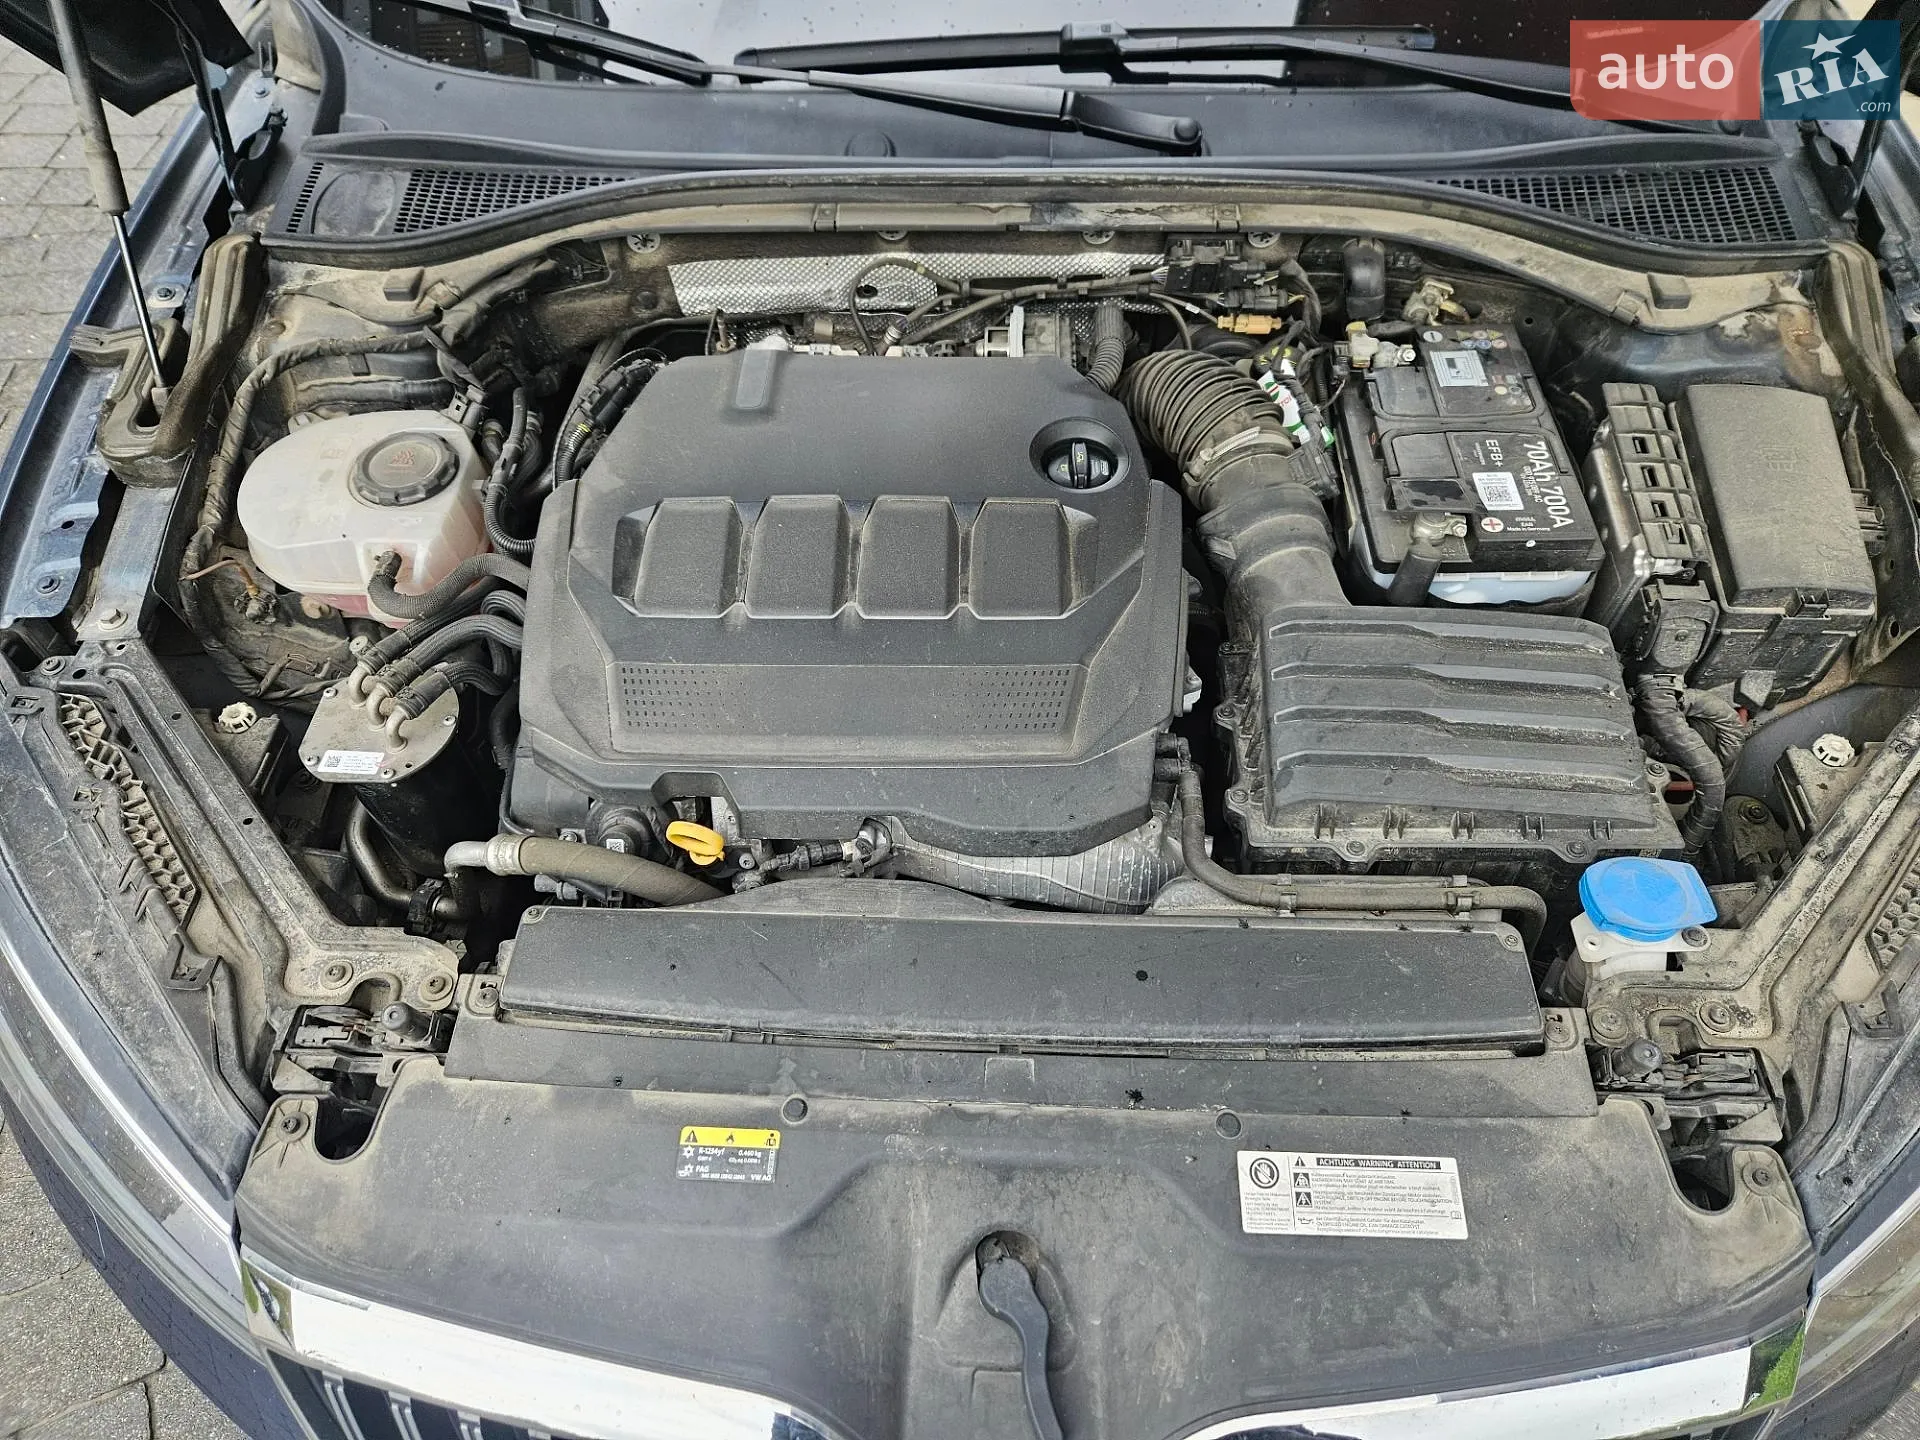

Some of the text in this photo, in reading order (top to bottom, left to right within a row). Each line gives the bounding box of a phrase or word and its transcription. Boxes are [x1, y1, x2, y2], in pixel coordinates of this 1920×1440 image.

[1485, 439, 1504, 467] EFB+
[1523, 441, 1556, 482] 70Ah
[1540, 486, 1575, 529] 700A
[695, 1165, 709, 1173] PAG
[1319, 1158, 1437, 1169] ACHTUNG WARNING ATTENTION
